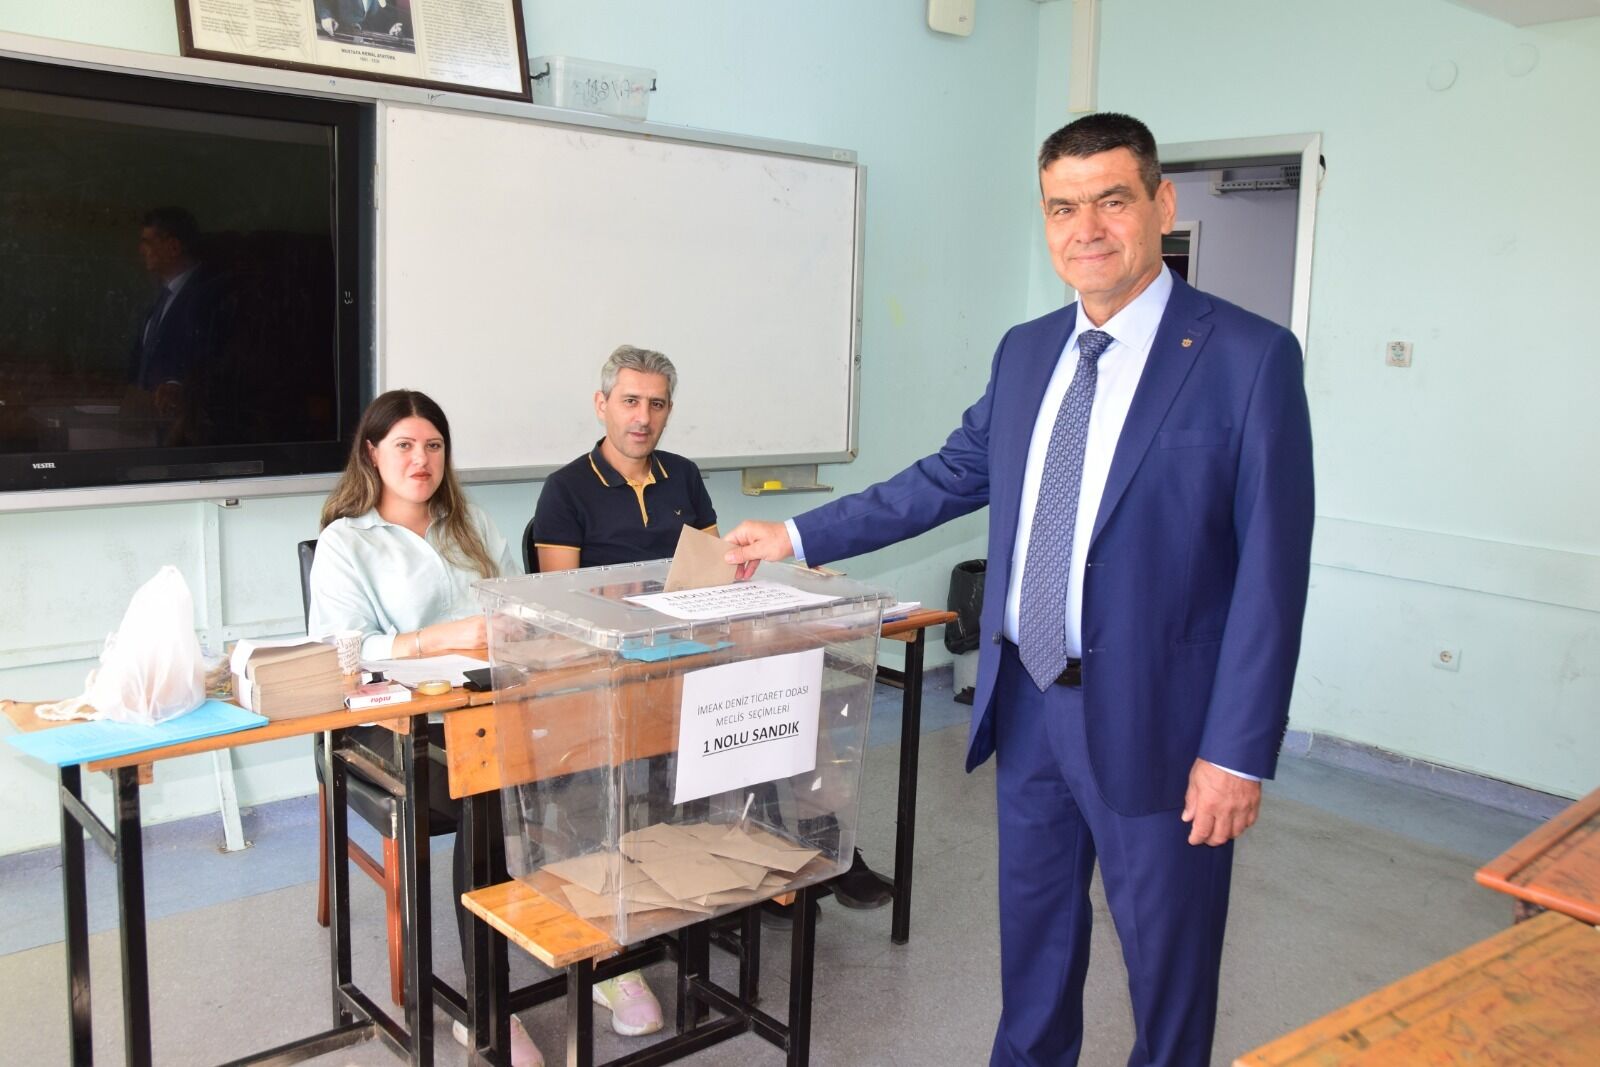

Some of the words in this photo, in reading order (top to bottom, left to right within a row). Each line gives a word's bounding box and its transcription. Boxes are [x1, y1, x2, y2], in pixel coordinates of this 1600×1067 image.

[697, 701, 723, 716] İMEAK
[725, 695, 749, 710] DENİZ
[751, 690, 783, 704] TİCARET
[785, 685, 809, 699] ODASI
[716, 712, 745, 727] MECLİS
[748, 704, 790, 721] SEÇİMLERİ
[703, 739, 710, 754] 1
[714, 730, 749, 751] NOLU
[752, 720, 800, 742] SANDIK
